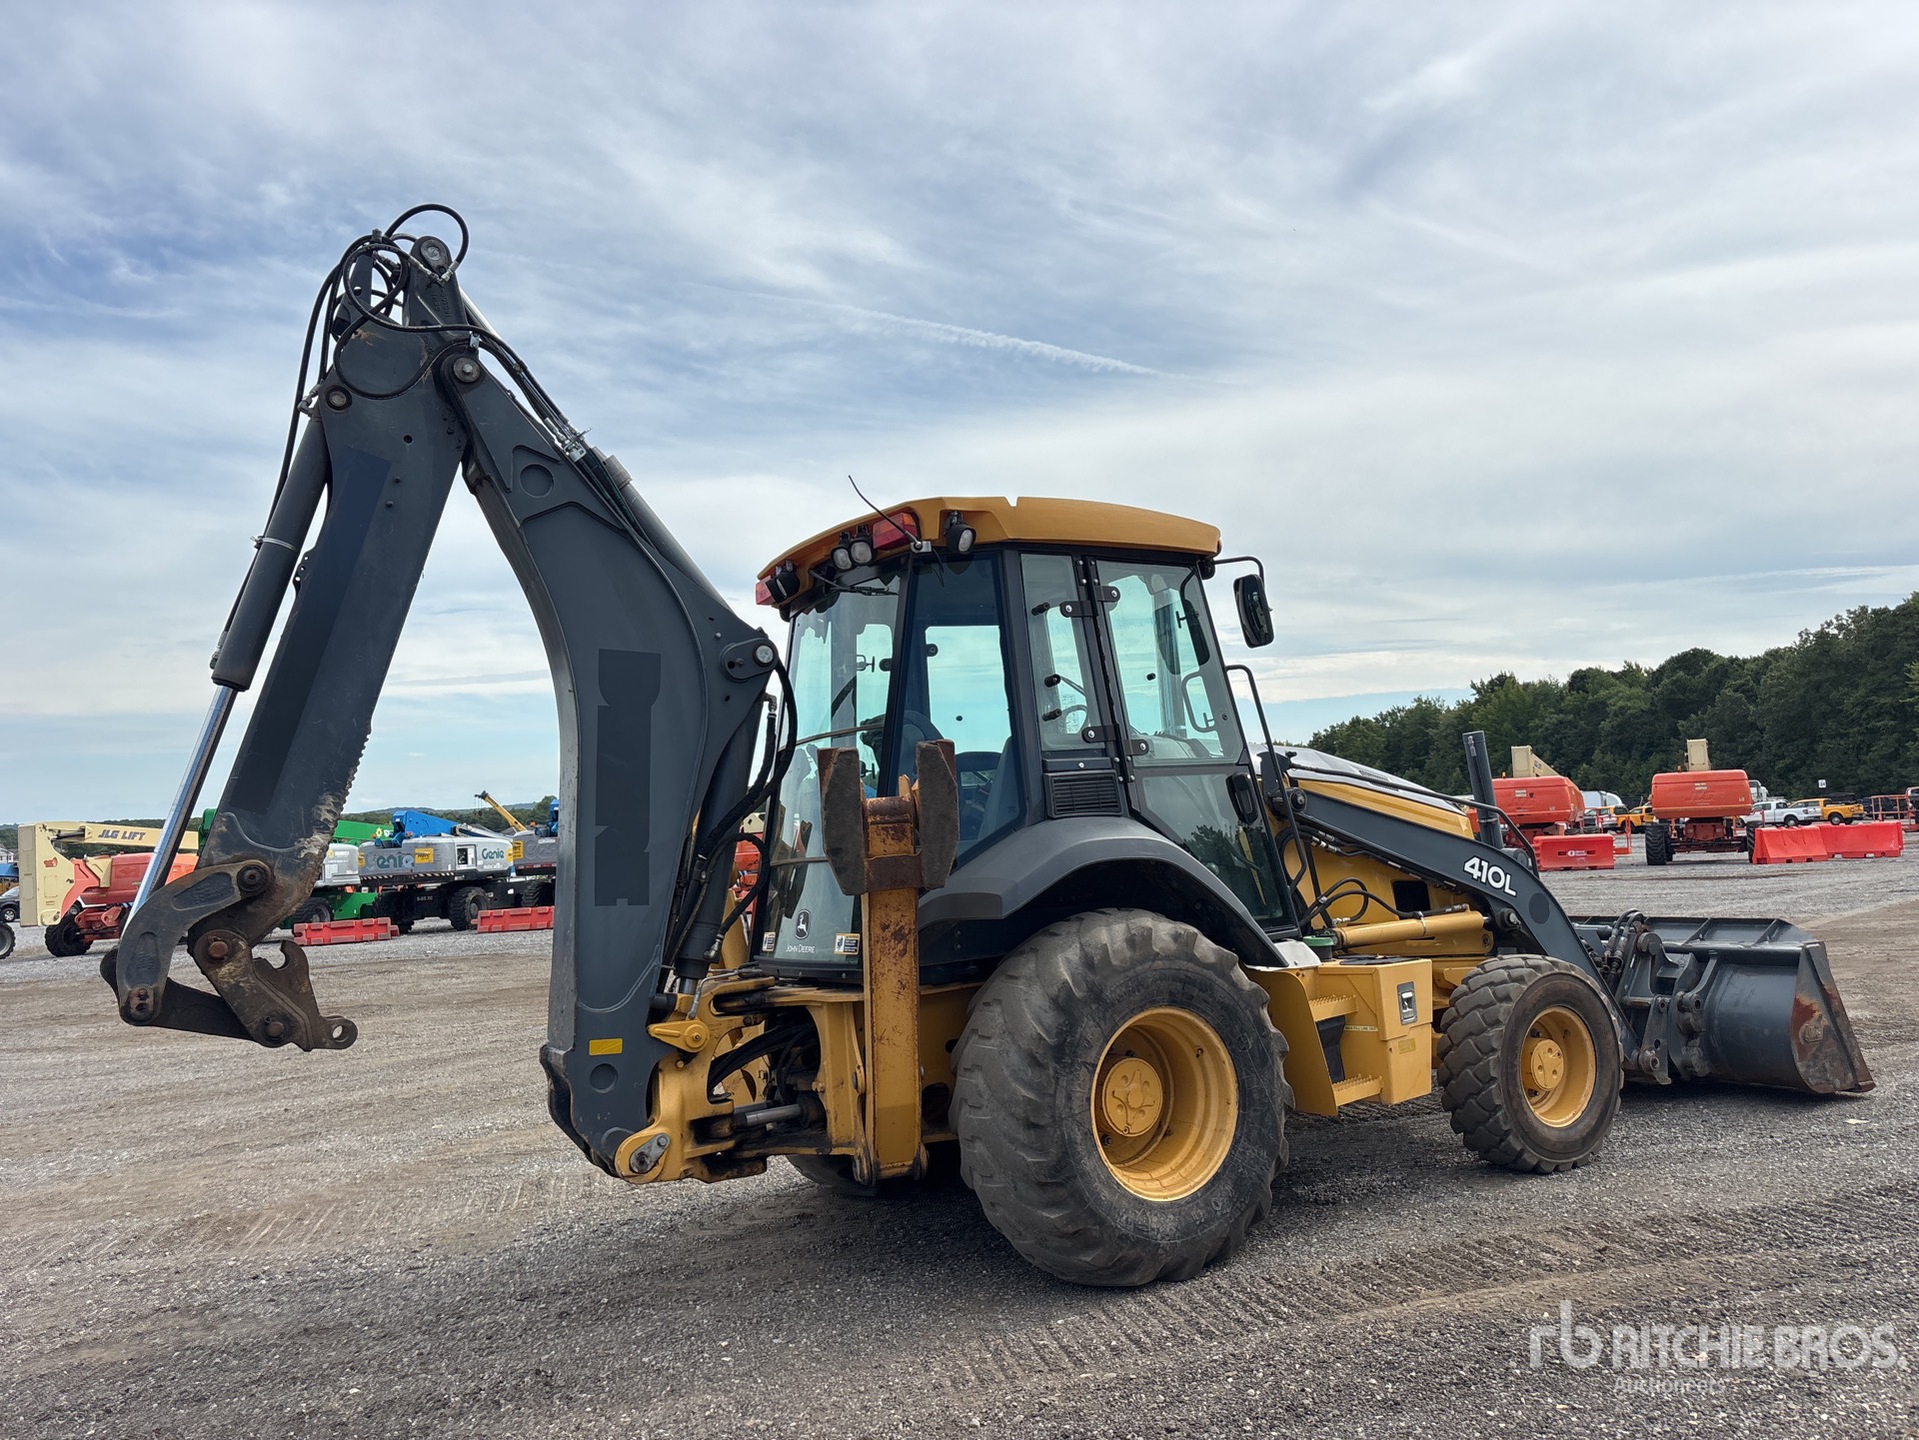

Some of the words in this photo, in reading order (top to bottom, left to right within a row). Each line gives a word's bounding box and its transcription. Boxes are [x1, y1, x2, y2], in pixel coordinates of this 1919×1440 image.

[98, 829, 120, 839] JLG
[121, 831, 146, 841] LIFT
[366, 850, 415, 869] Geni
[482, 848, 505, 860] Genie
[1463, 855, 1517, 897] 410L
[786, 945, 798, 953] JOHN
[799, 944, 815, 953] DEERE
